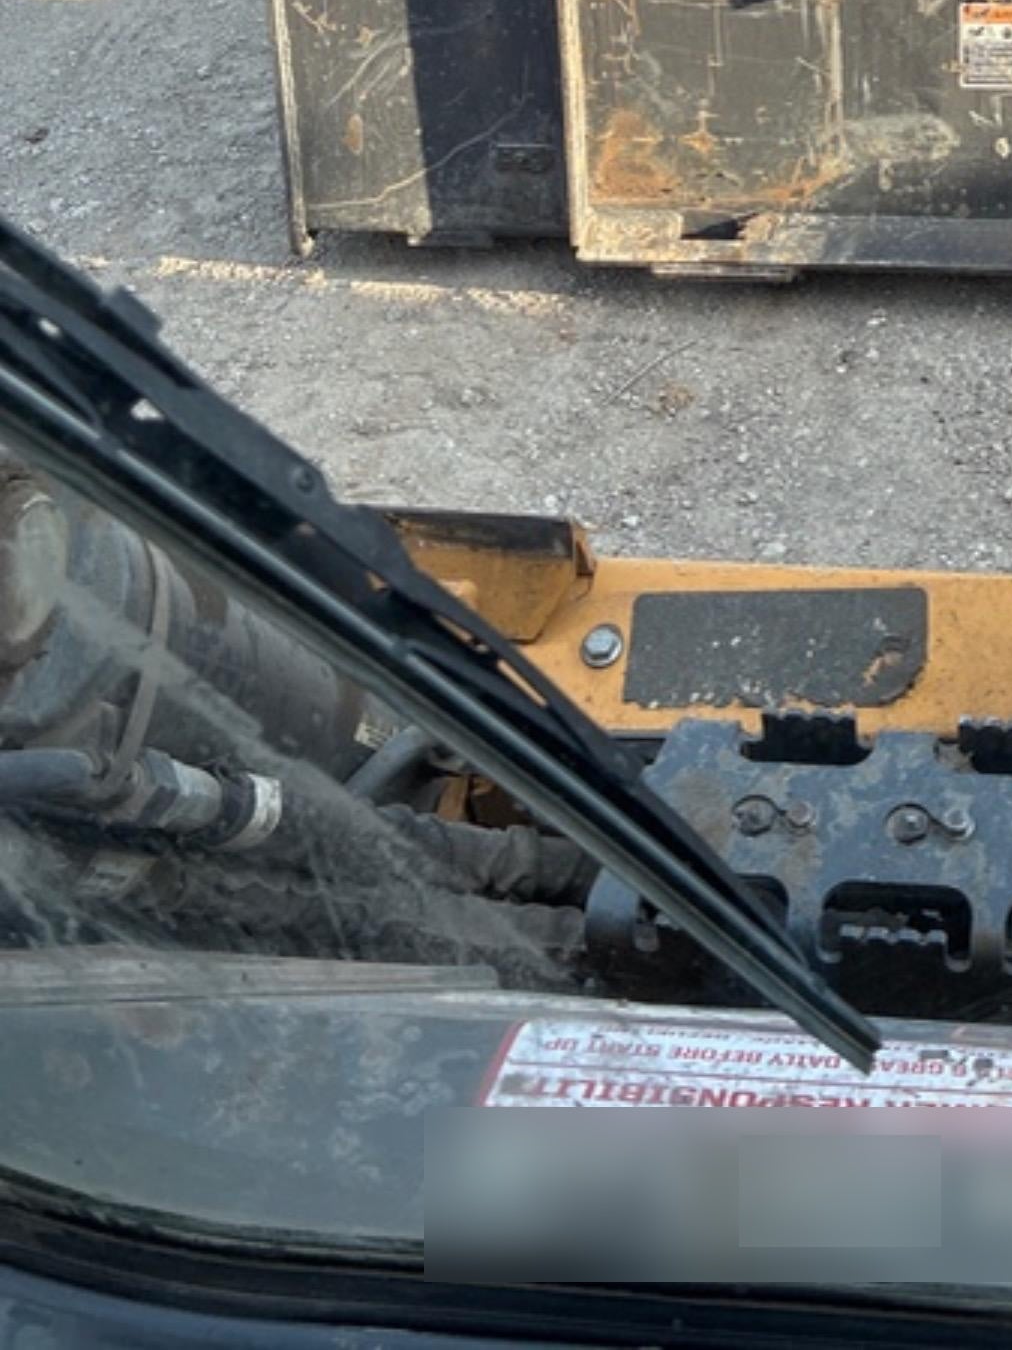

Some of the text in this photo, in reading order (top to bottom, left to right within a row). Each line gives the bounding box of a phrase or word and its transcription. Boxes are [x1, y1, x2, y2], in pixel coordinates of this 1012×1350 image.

[541, 1038, 579, 1052] UP
[587, 1038, 661, 1057] START
[669, 1047, 763, 1066] BEFORE
[767, 1054, 841, 1069] DAILY
[873, 1060, 943, 1076] GREA
